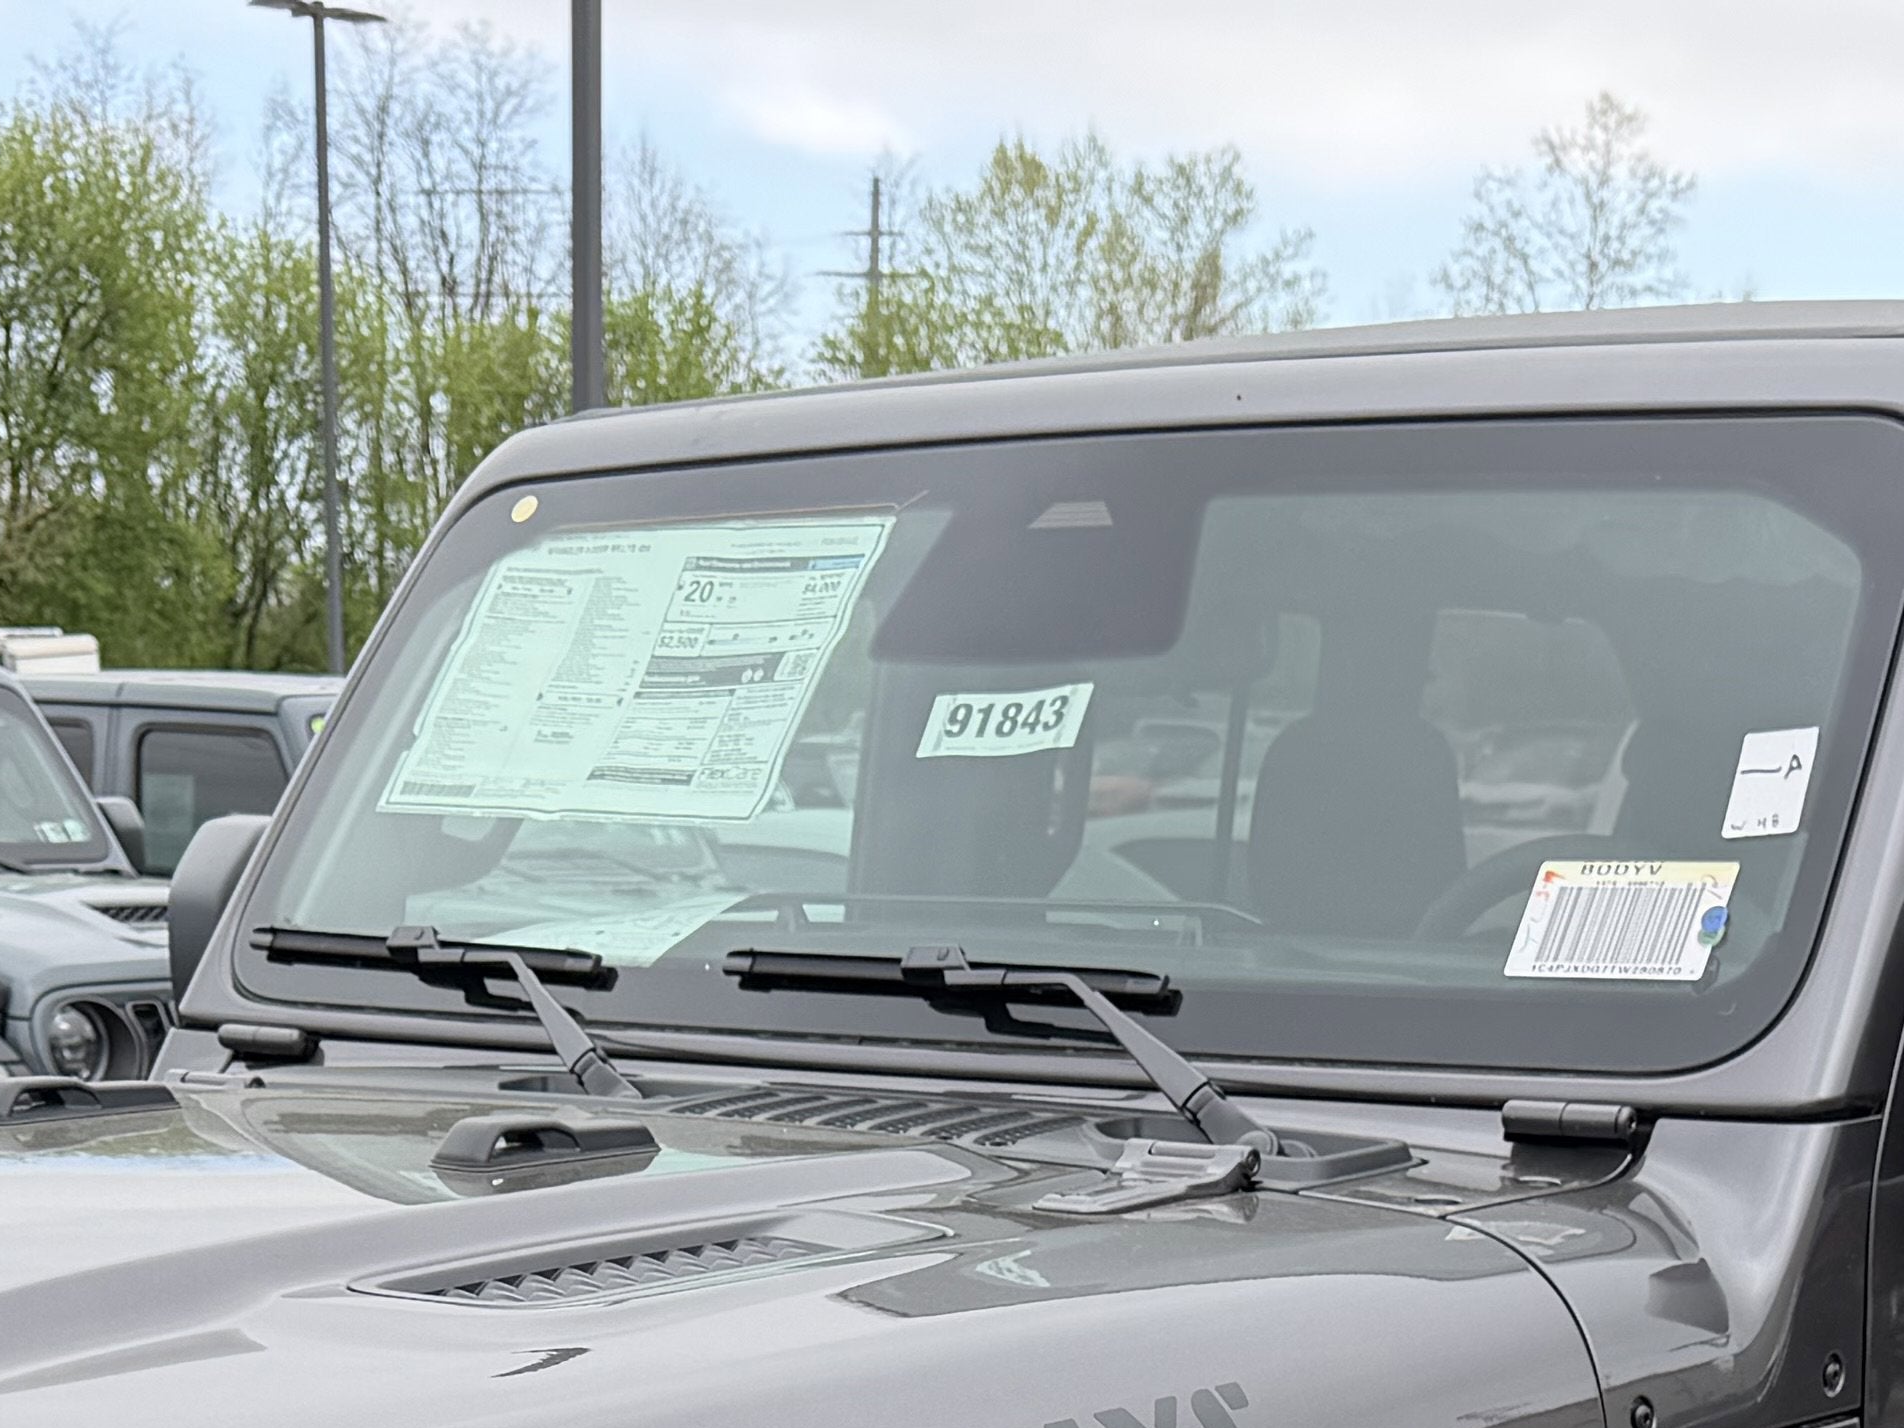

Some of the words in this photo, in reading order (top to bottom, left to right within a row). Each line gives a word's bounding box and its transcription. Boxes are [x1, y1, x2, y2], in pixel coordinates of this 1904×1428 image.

[683, 580, 714, 603] 20
[944, 695, 1070, 738] 91843
[1580, 864, 1663, 876] BODYV
